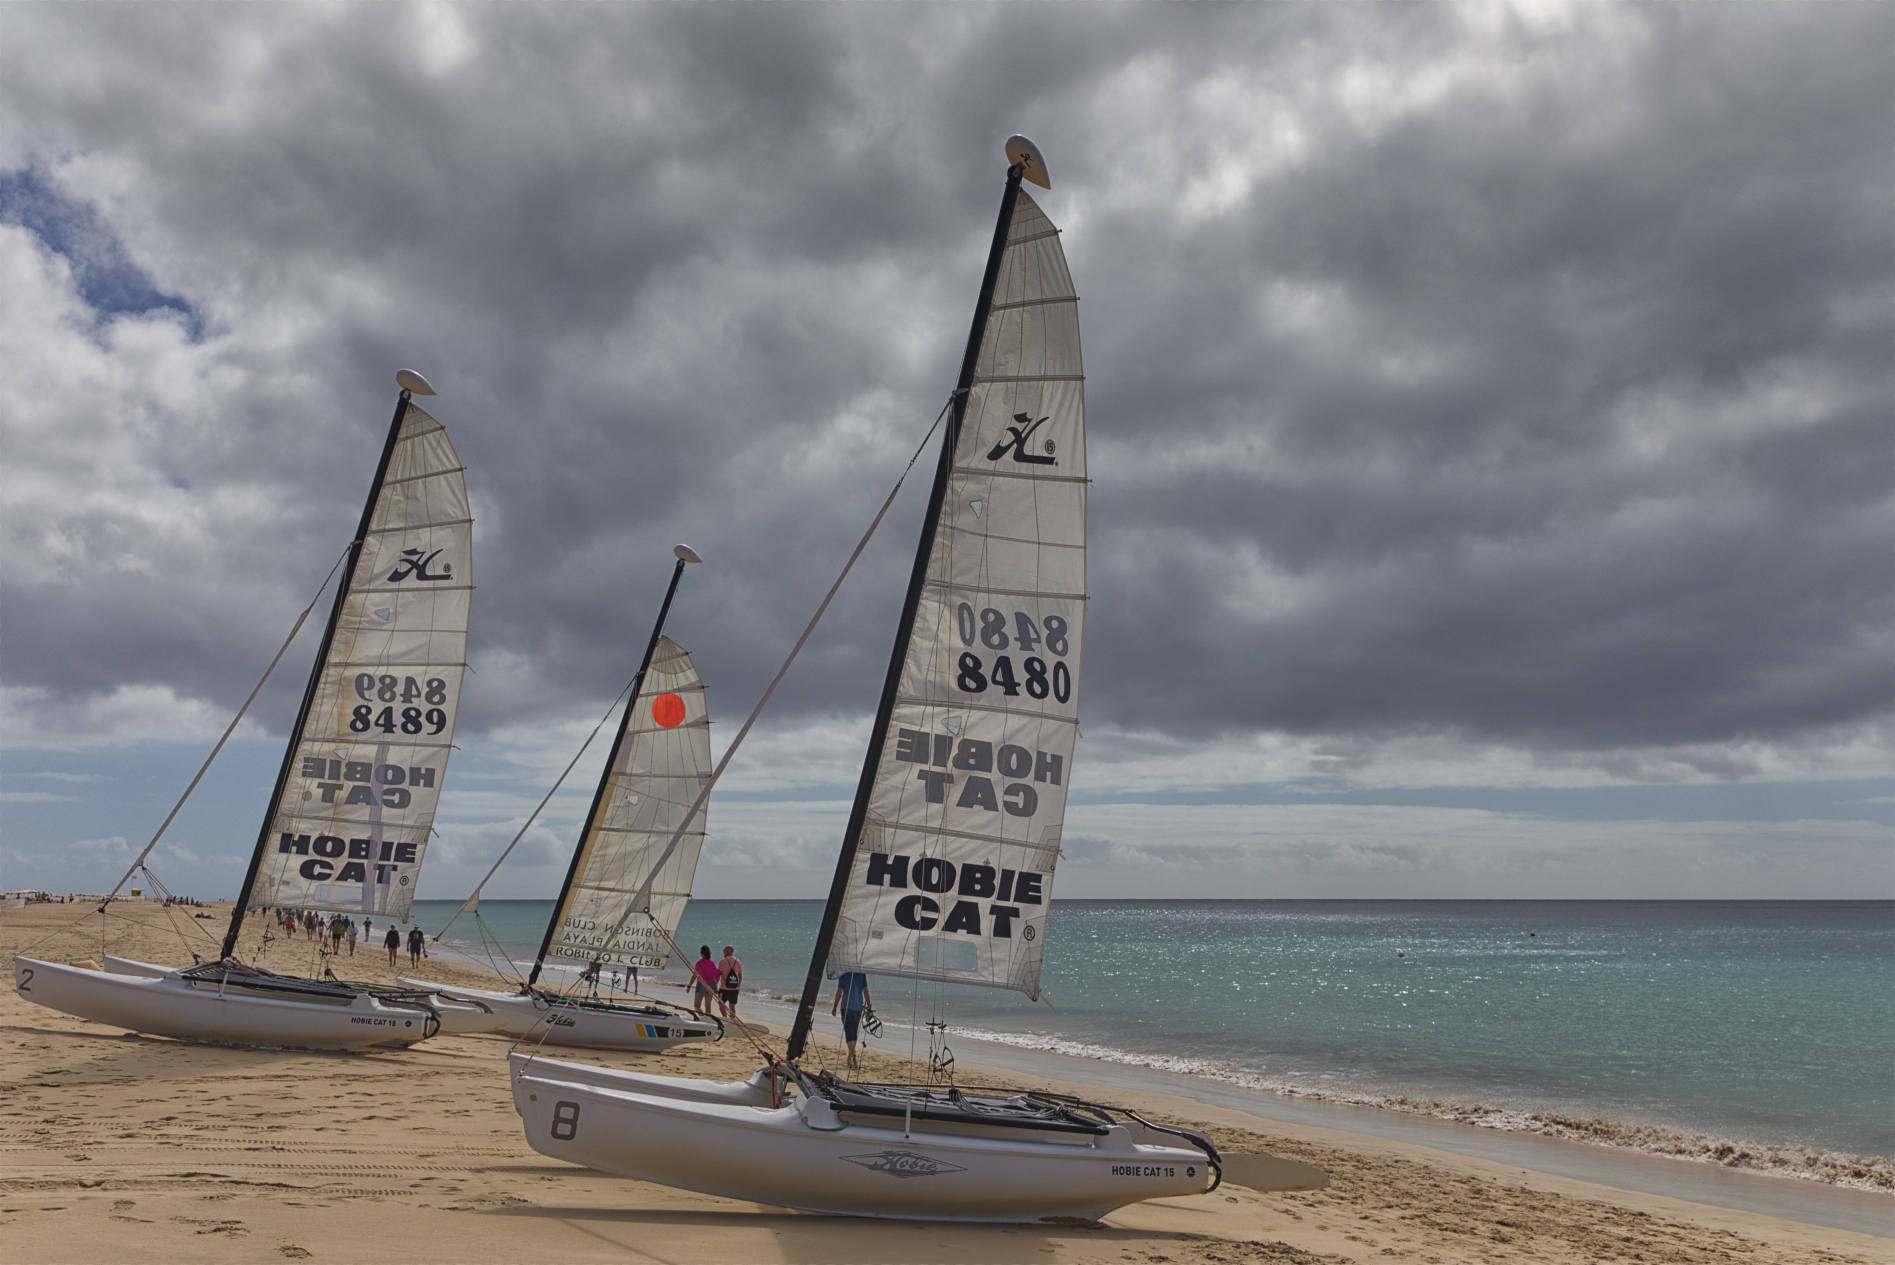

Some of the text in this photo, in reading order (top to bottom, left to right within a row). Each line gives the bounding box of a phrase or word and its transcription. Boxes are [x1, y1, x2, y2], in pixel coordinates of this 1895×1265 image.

[957, 651, 1071, 704] 8480
[350, 704, 447, 736] 8489
[278, 832, 418, 863] HOBIE
[299, 858, 398, 885] CAT
[866, 852, 1043, 905] HOBIE
[894, 895, 1021, 939] CAT
[18, 968, 35, 992] 2
[351, 1016, 373, 1025] HOBIE
[373, 1018, 388, 1026] CAT
[670, 1028, 683, 1038] 15
[551, 1100, 580, 1141] 8
[1111, 1165, 1175, 1177] HOBIE CAT 15
